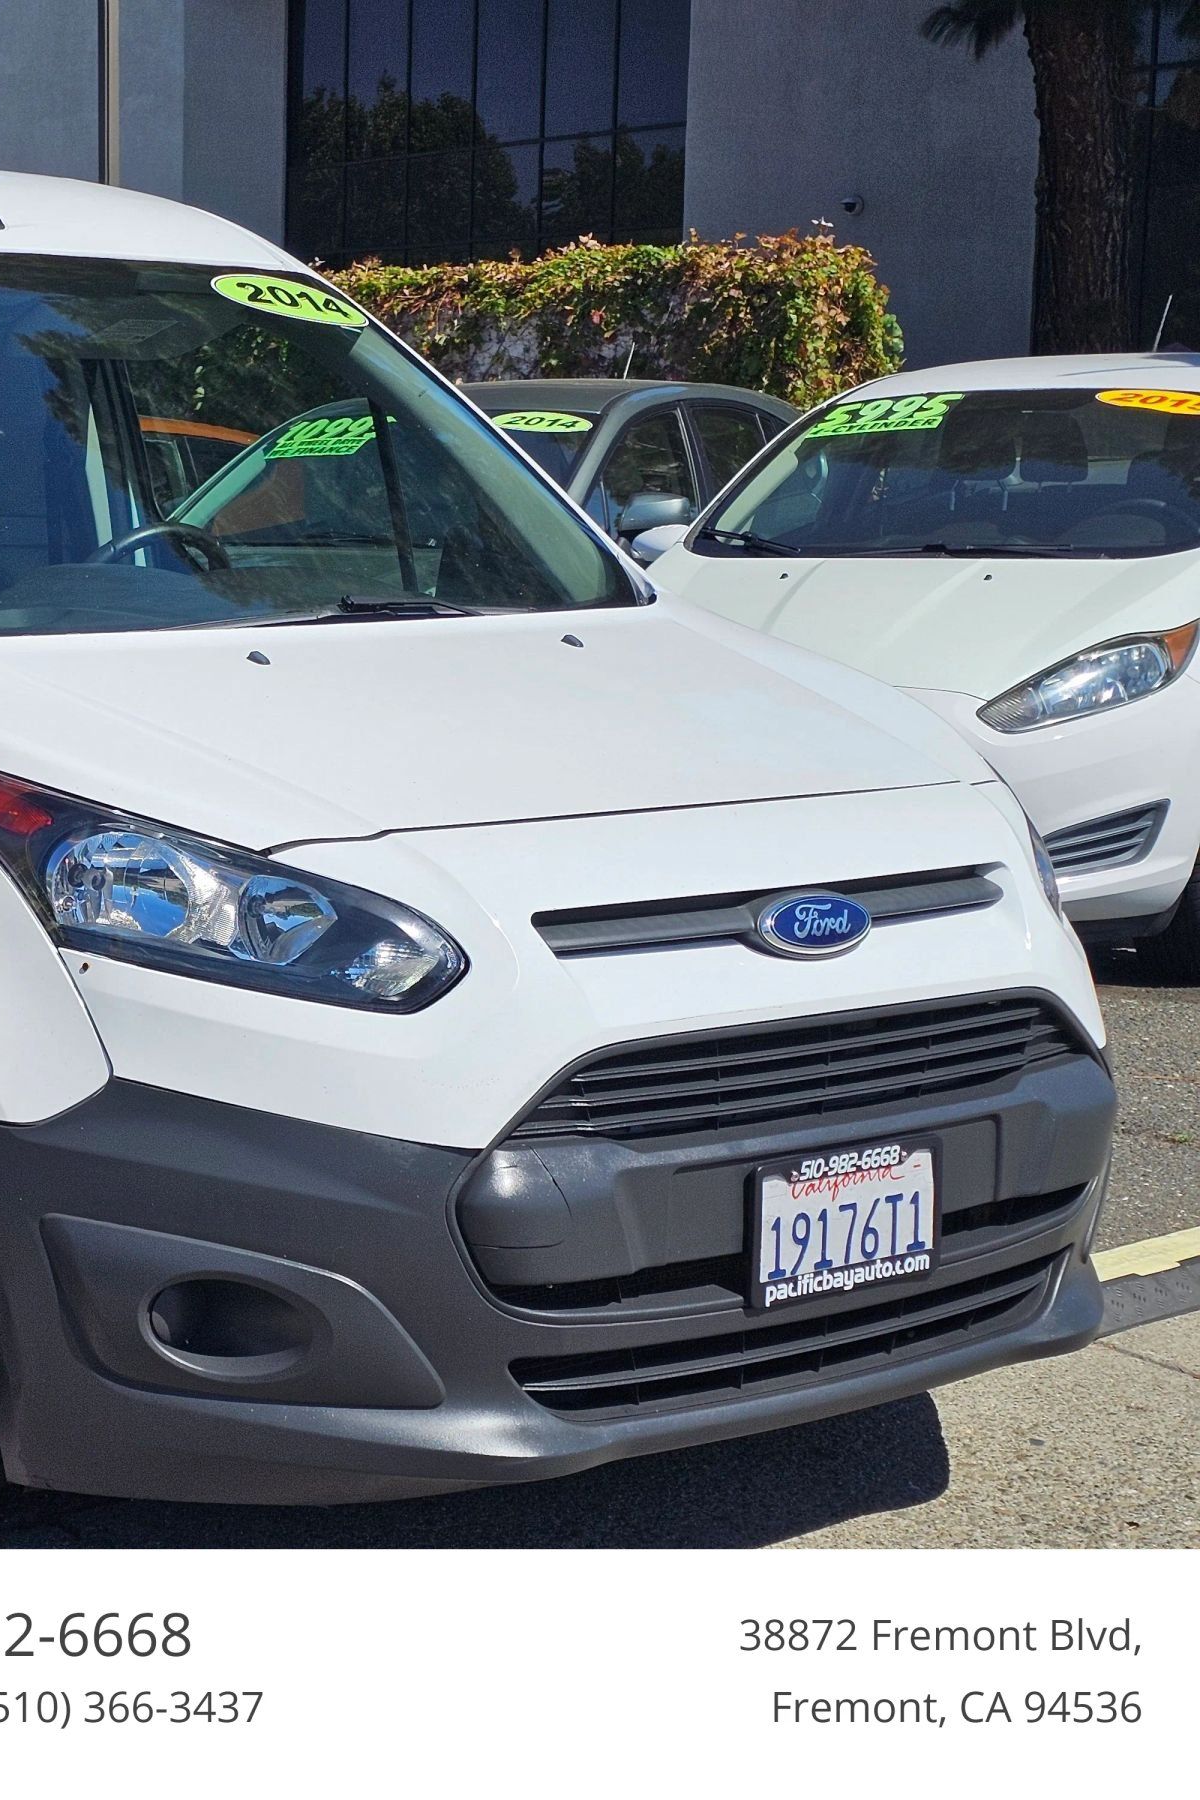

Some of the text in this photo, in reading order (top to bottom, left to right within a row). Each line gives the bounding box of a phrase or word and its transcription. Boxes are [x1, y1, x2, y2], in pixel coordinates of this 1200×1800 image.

[236, 282, 352, 319] 2014
[504, 415, 581, 429] 2014
[817, 394, 966, 428] 5995
[277, 416, 397, 442] 1099
[293, 446, 359, 455] FINANCE
[794, 903, 852, 938] Ford
[799, 1145, 901, 1181] 510-982-6668
[767, 1191, 926, 1281] 19176T1
[765, 1254, 931, 1308] pacificbayauto.com
